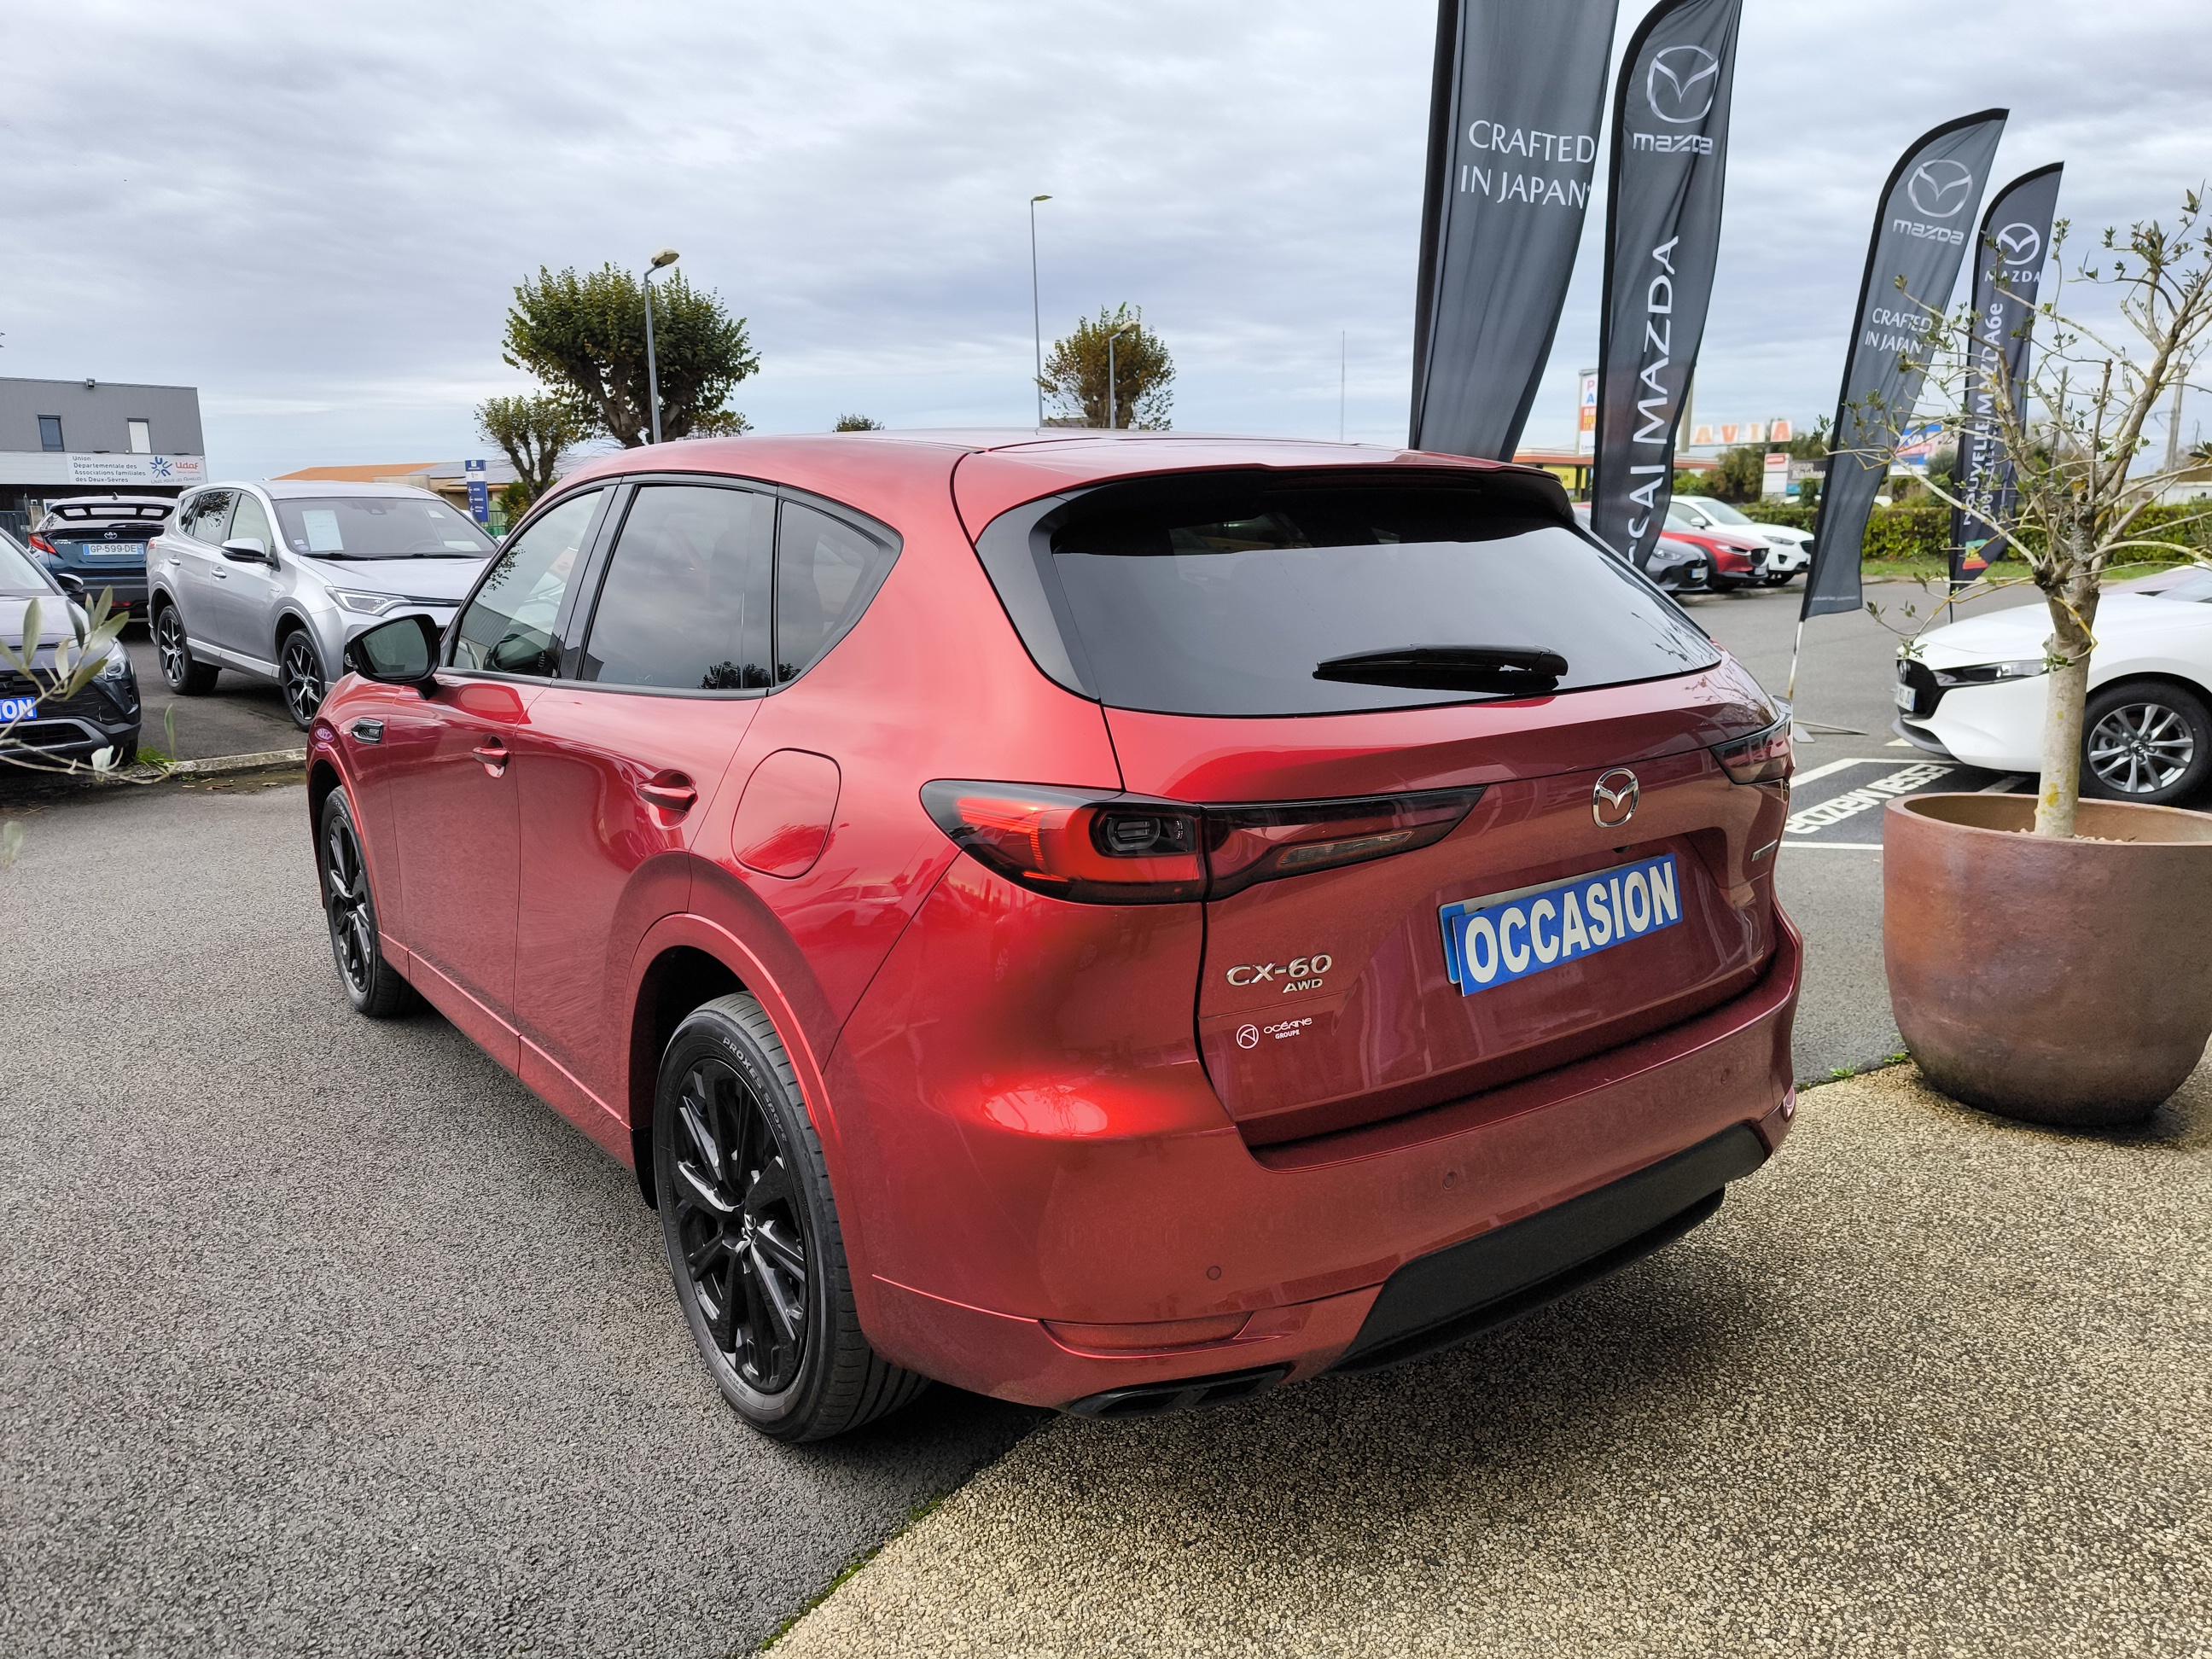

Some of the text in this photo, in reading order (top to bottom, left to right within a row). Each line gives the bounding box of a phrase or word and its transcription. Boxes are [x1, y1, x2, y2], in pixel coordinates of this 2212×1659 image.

[1468, 119, 1595, 164] CRAFTED
[1633, 132, 1714, 155] mazda
[1460, 165, 1492, 196] IN
[1892, 218, 1965, 246] mazda
[1633, 235, 1679, 445] MAZDA
[1864, 330, 1924, 355] IN JAPAN
[1693, 422, 1791, 445] AVIA
[90, 544, 137, 553] GP-599-DE
[0, 699, 34, 719] ON
[1464, 861, 1679, 984] OCCASION
[1225, 953, 1333, 987] CX-60
[1283, 978, 1323, 993] AWD
[1275, 1029, 1301, 1039] GROUPE
[722, 1036, 762, 1090] PROXES
